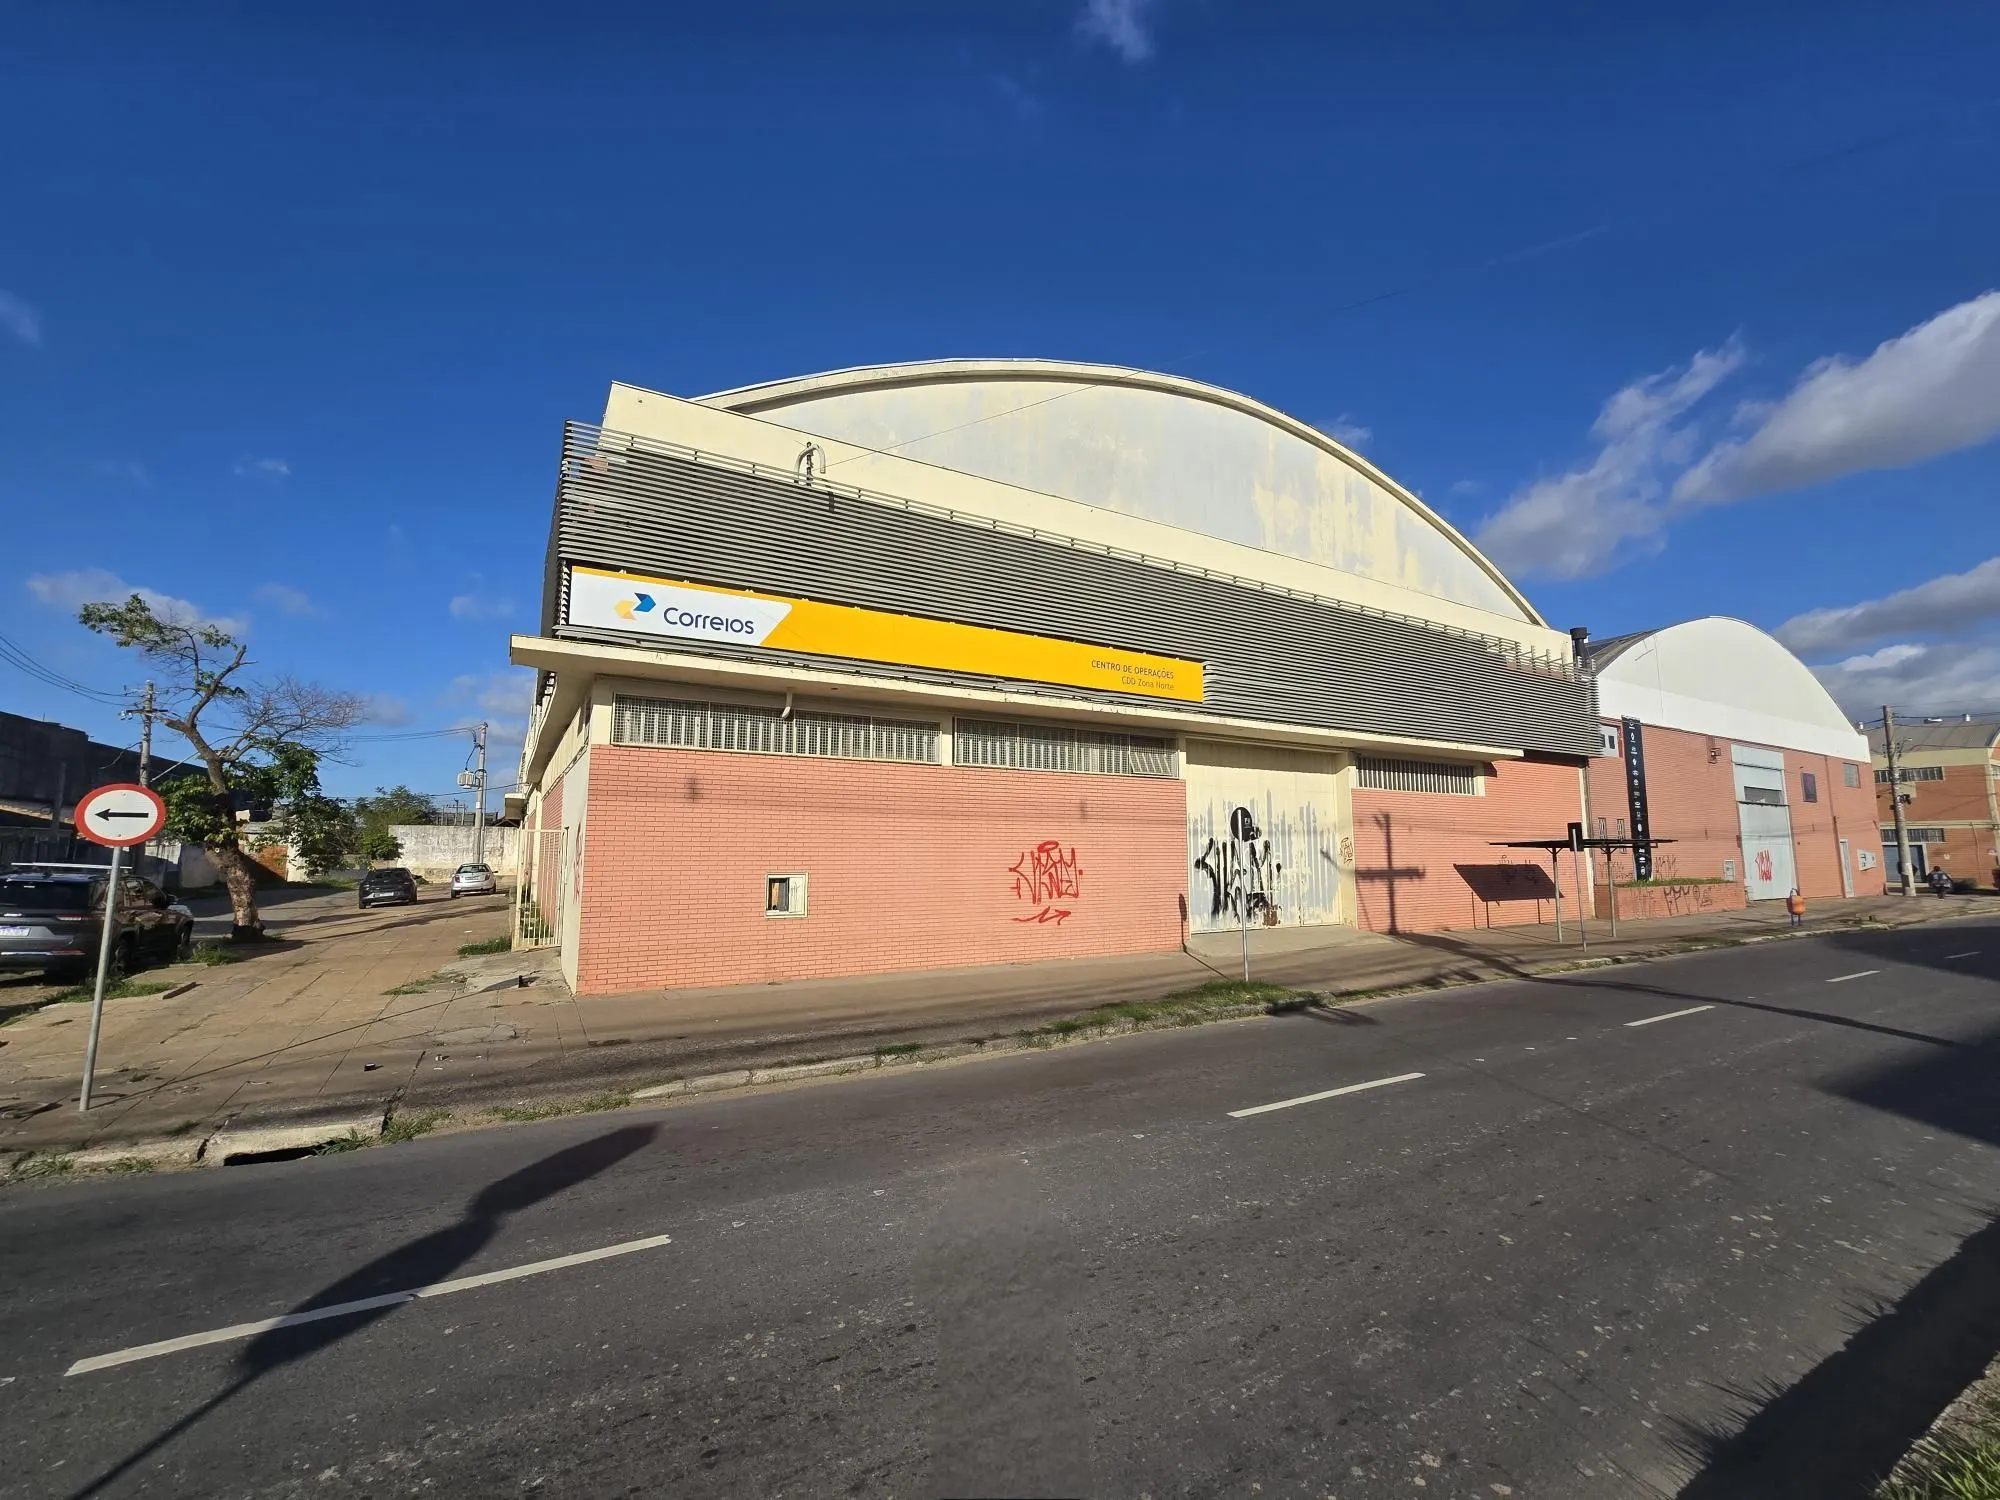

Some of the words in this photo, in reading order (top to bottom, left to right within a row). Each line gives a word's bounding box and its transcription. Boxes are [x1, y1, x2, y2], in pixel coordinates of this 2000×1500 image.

[664, 607, 754, 635] Correios
[1091, 660, 1121, 672] CENTRO
[1123, 664, 1132, 673] DE
[1134, 666, 1174, 679] OPERAÇÕES
[1121, 676, 1136, 686] CDD
[1138, 679, 1154, 688] Zona
[1156, 681, 1174, 690] Norte
